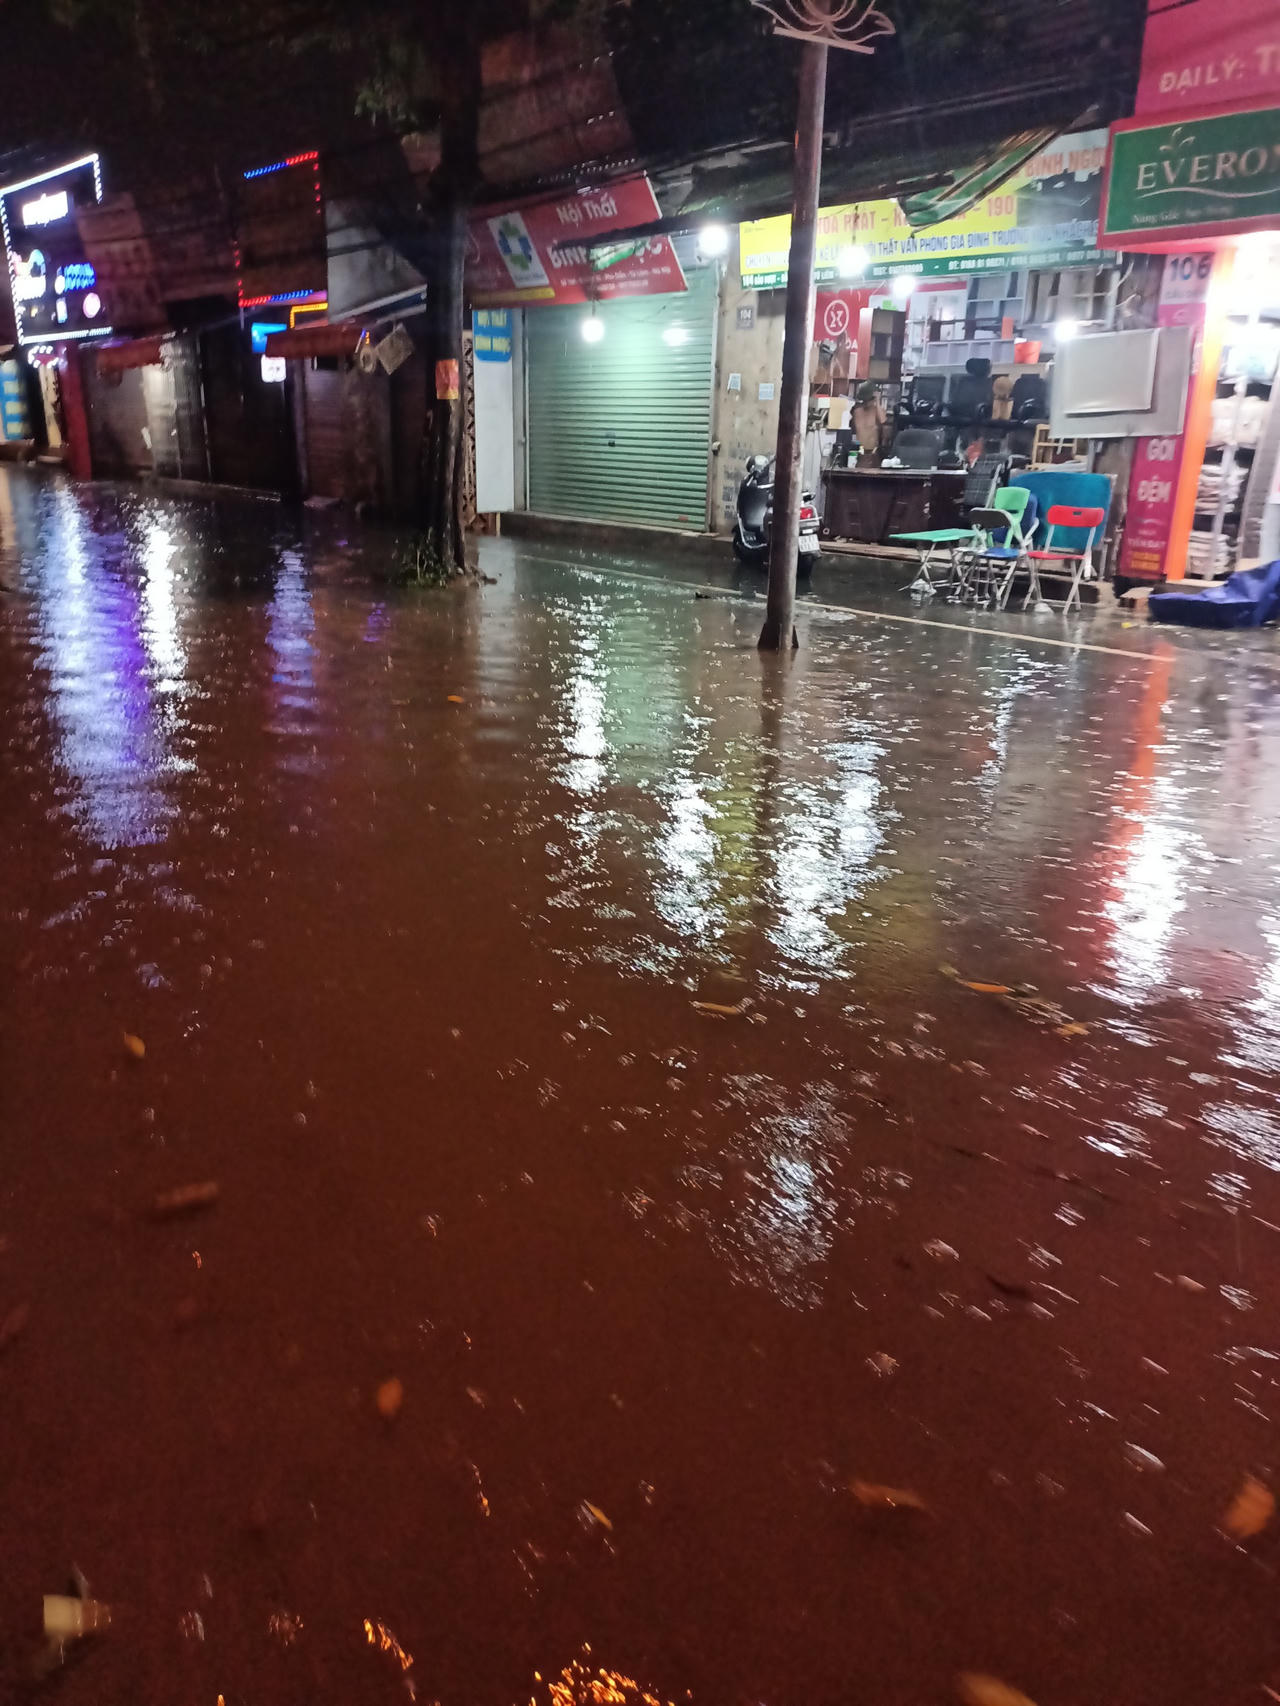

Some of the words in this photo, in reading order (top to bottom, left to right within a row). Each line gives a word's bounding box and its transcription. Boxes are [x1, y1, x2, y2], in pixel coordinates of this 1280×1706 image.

[556, 202, 582, 227] Nội
[582, 192, 618, 219] Thất
[987, 195, 1015, 217] 190
[1169, 255, 1212, 282] 106
